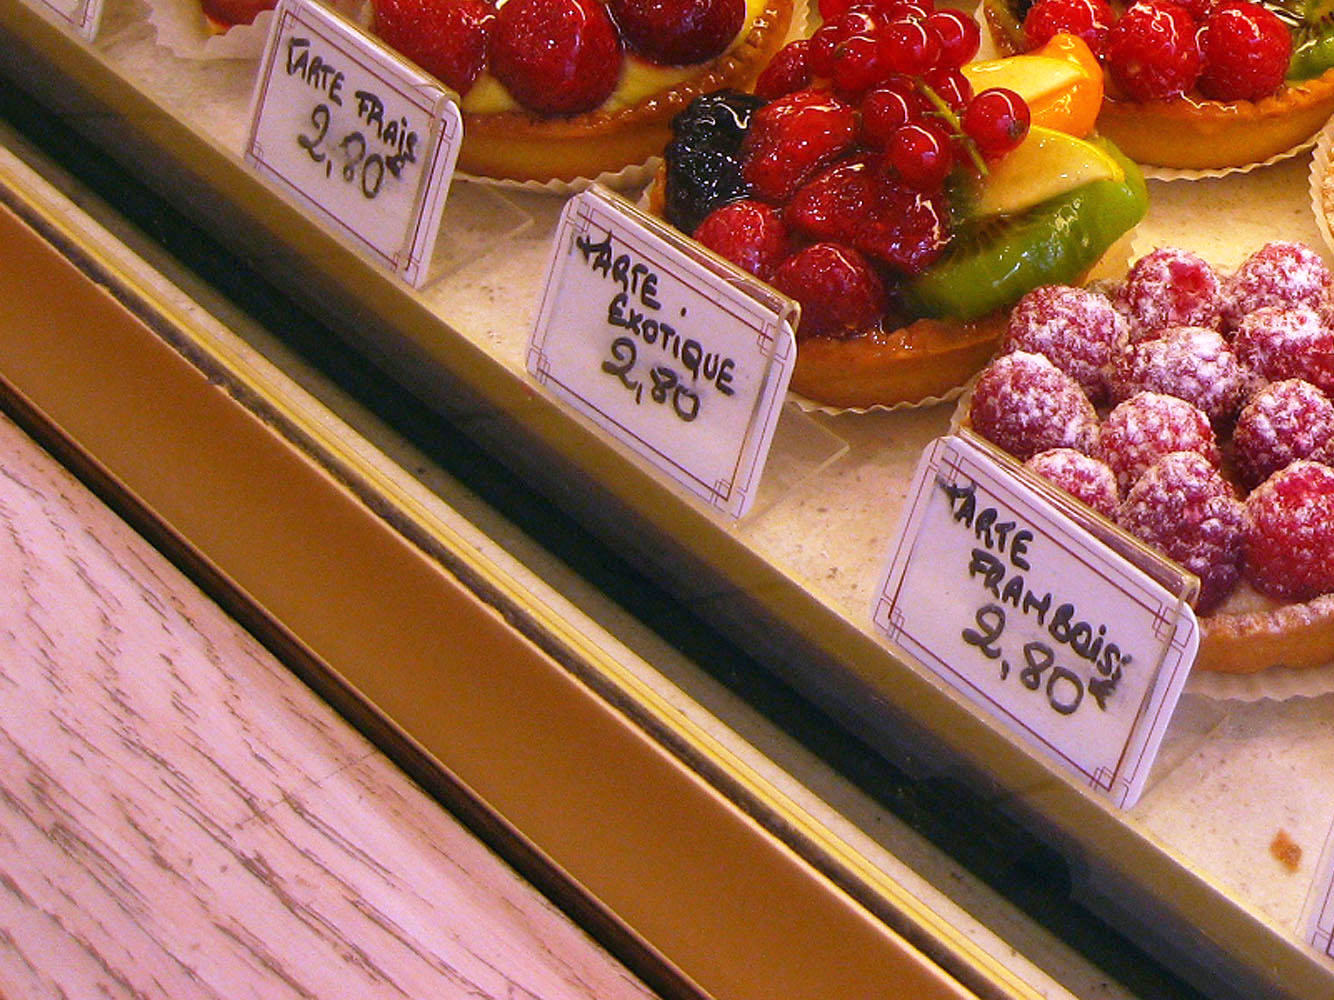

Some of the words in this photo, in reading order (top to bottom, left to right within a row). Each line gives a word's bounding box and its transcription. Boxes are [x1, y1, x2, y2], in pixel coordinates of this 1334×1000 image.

[286, 37, 345, 106] TARTE
[576, 230, 661, 311] TARTE
[602, 337, 700, 422] 2,80
[936, 473, 1033, 570] TARTE
